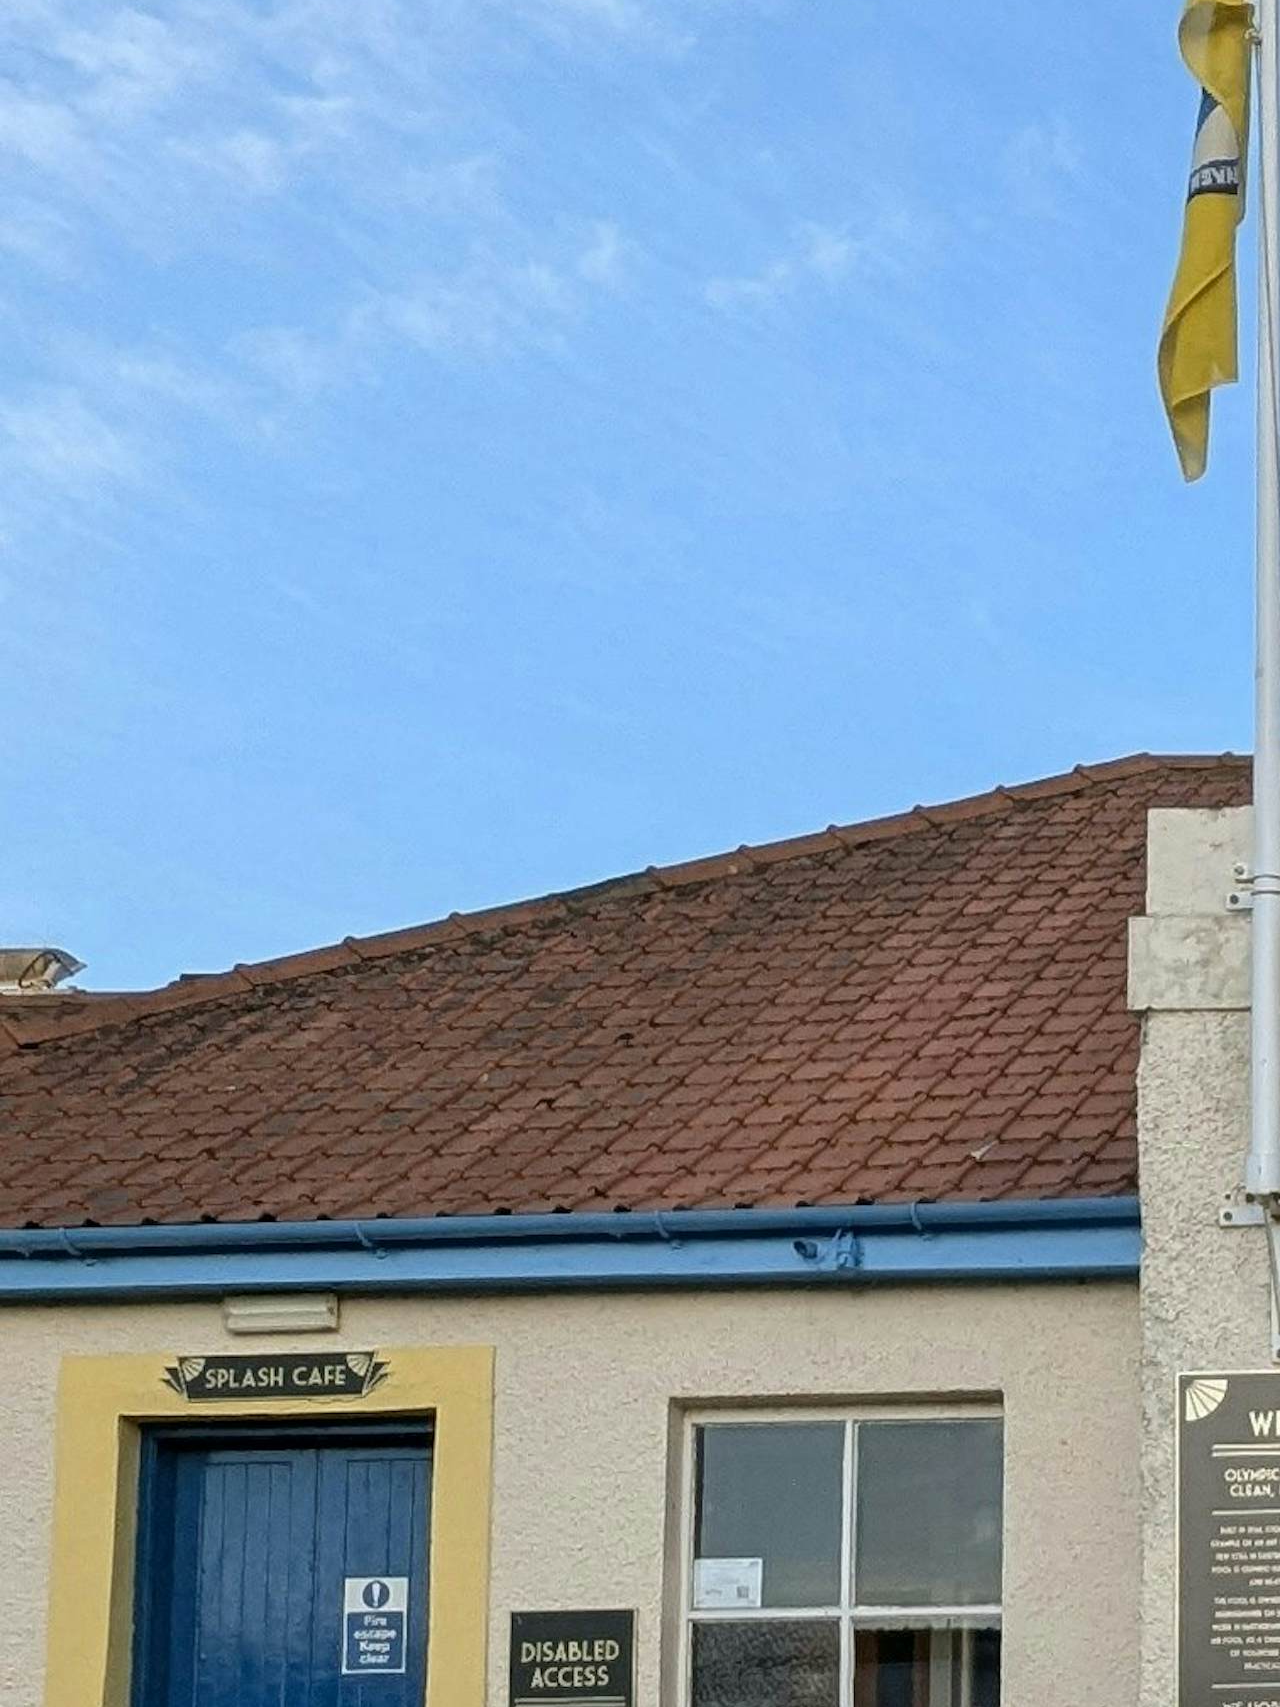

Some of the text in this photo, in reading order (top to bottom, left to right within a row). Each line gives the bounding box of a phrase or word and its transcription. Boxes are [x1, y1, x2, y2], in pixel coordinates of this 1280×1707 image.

[205, 1365, 347, 1389] SPLASH CAFE
[1229, 1483, 1275, 1498] CLEAN,
[520, 1639, 621, 1664] DISABLED
[529, 1665, 610, 1689] ACCESS
